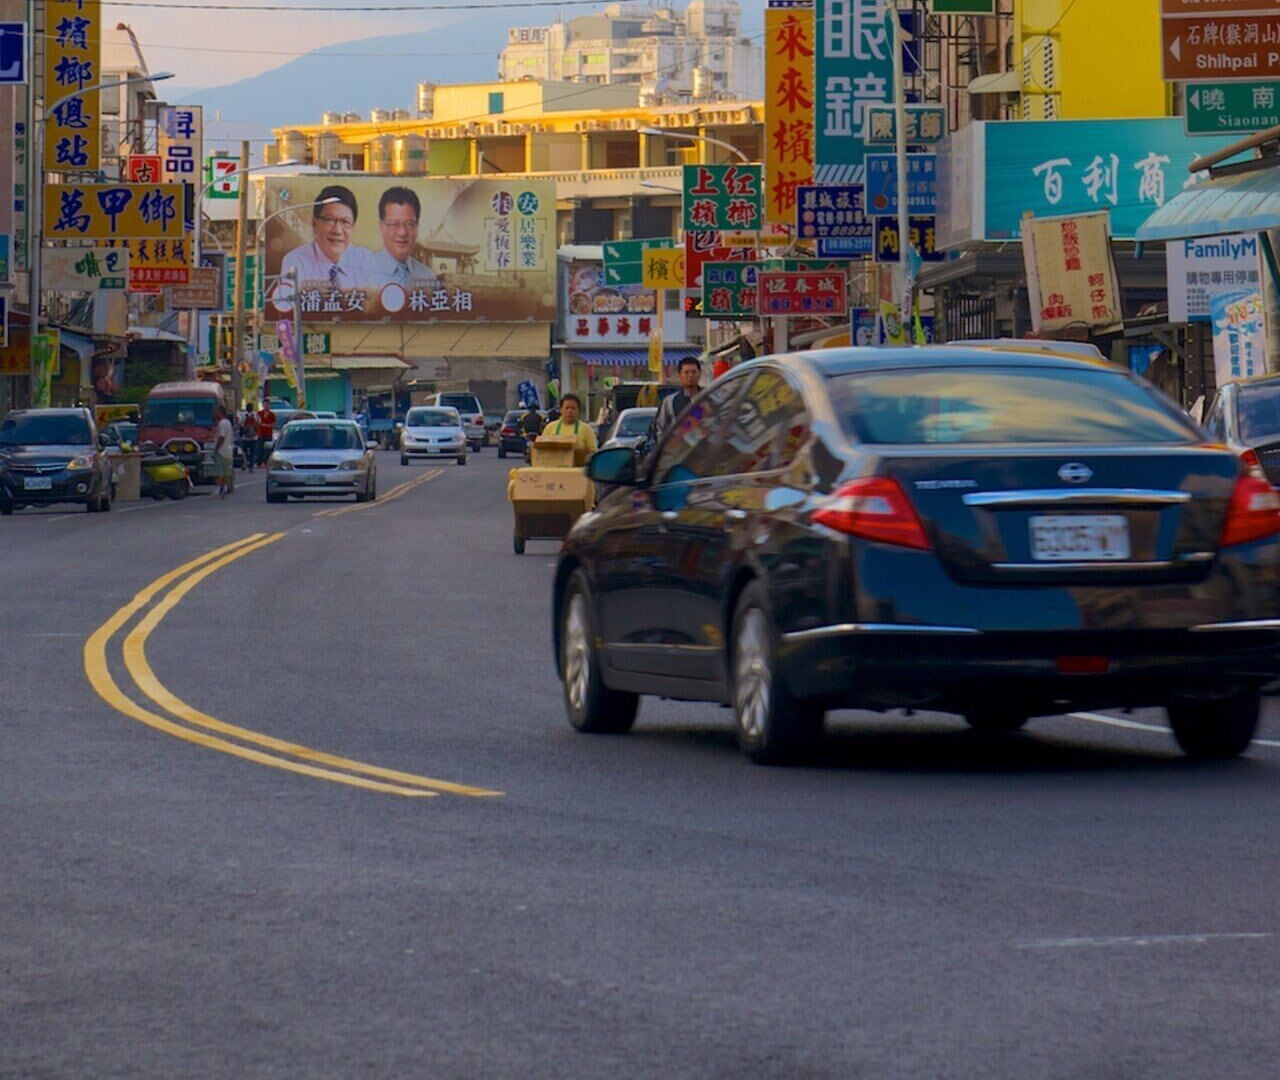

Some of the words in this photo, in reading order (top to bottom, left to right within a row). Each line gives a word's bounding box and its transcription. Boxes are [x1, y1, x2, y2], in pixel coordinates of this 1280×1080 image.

[1196, 52, 1259, 71] Shihpai
[1217, 113, 1279, 127] Siaonan
[1032, 151, 1212, 206] 百利商
[53, 188, 177, 234] 萬甲鄉
[765, 277, 840, 294] 恆春城
[300, 288, 366, 313] 潘孟安
[408, 289, 473, 313] 林亞相
